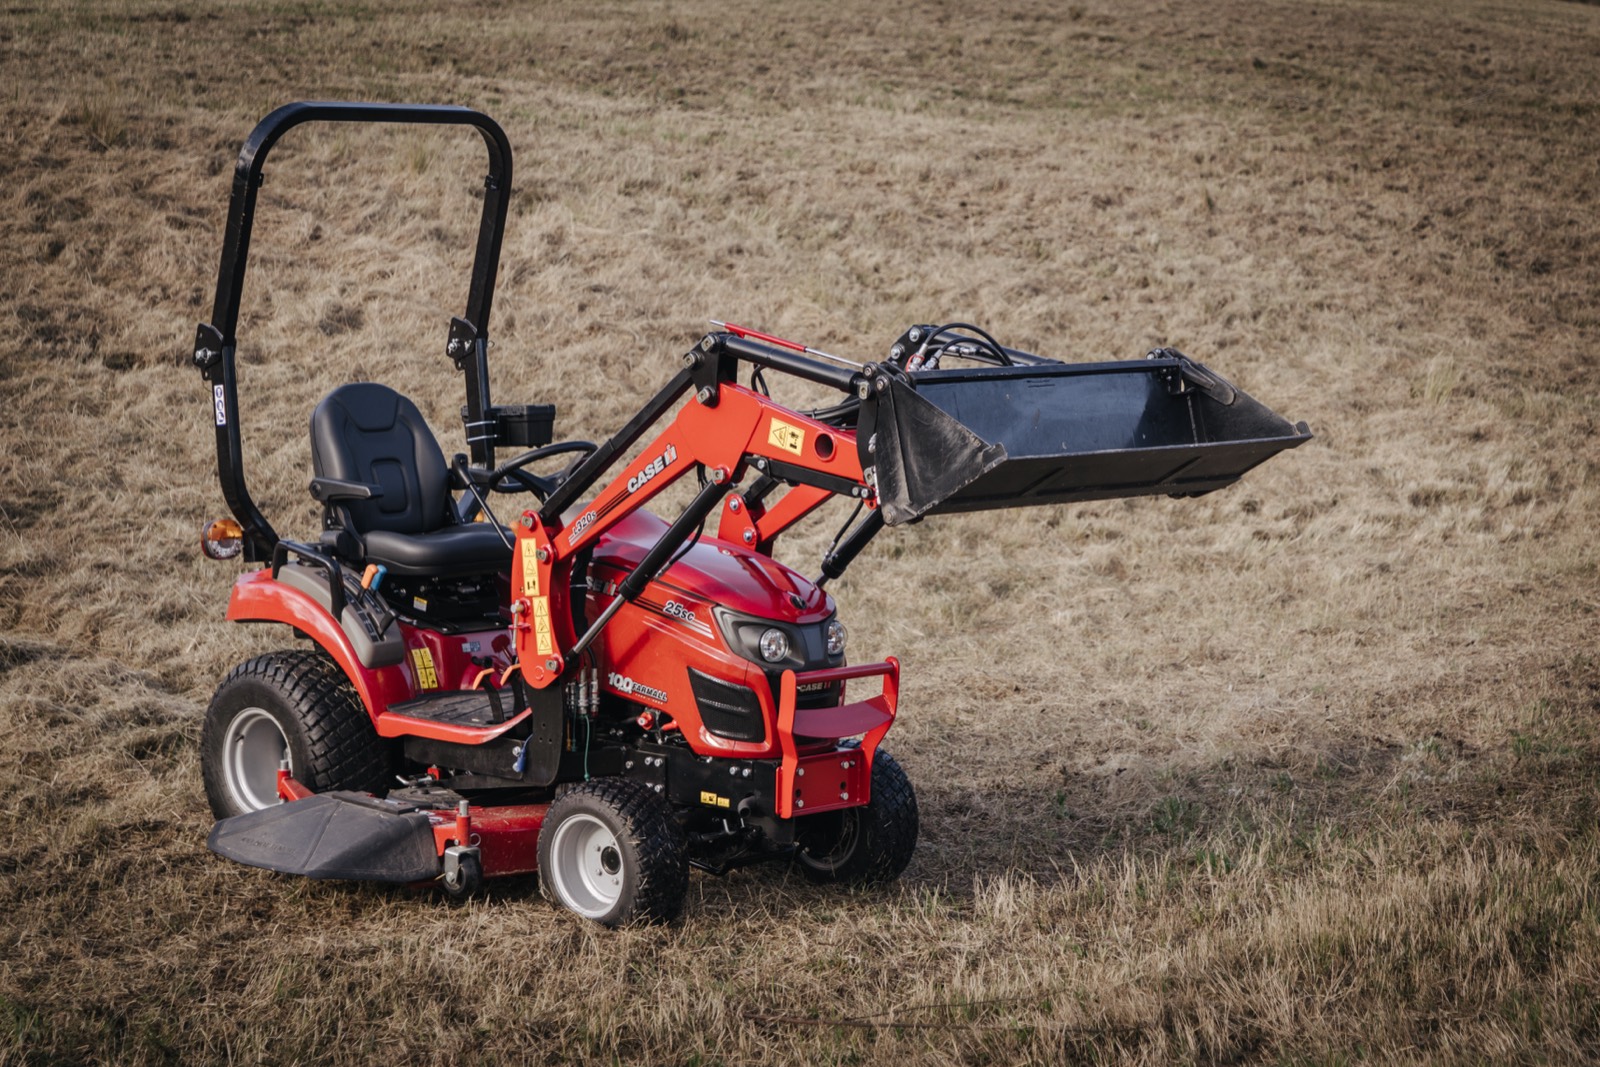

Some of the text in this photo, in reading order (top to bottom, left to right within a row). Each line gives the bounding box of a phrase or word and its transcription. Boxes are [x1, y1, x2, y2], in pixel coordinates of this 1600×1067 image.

[627, 455, 665, 494] CASE
[608, 672, 633, 692] 100
[632, 681, 668, 702] FARMALL
[799, 682, 823, 693] CASE
